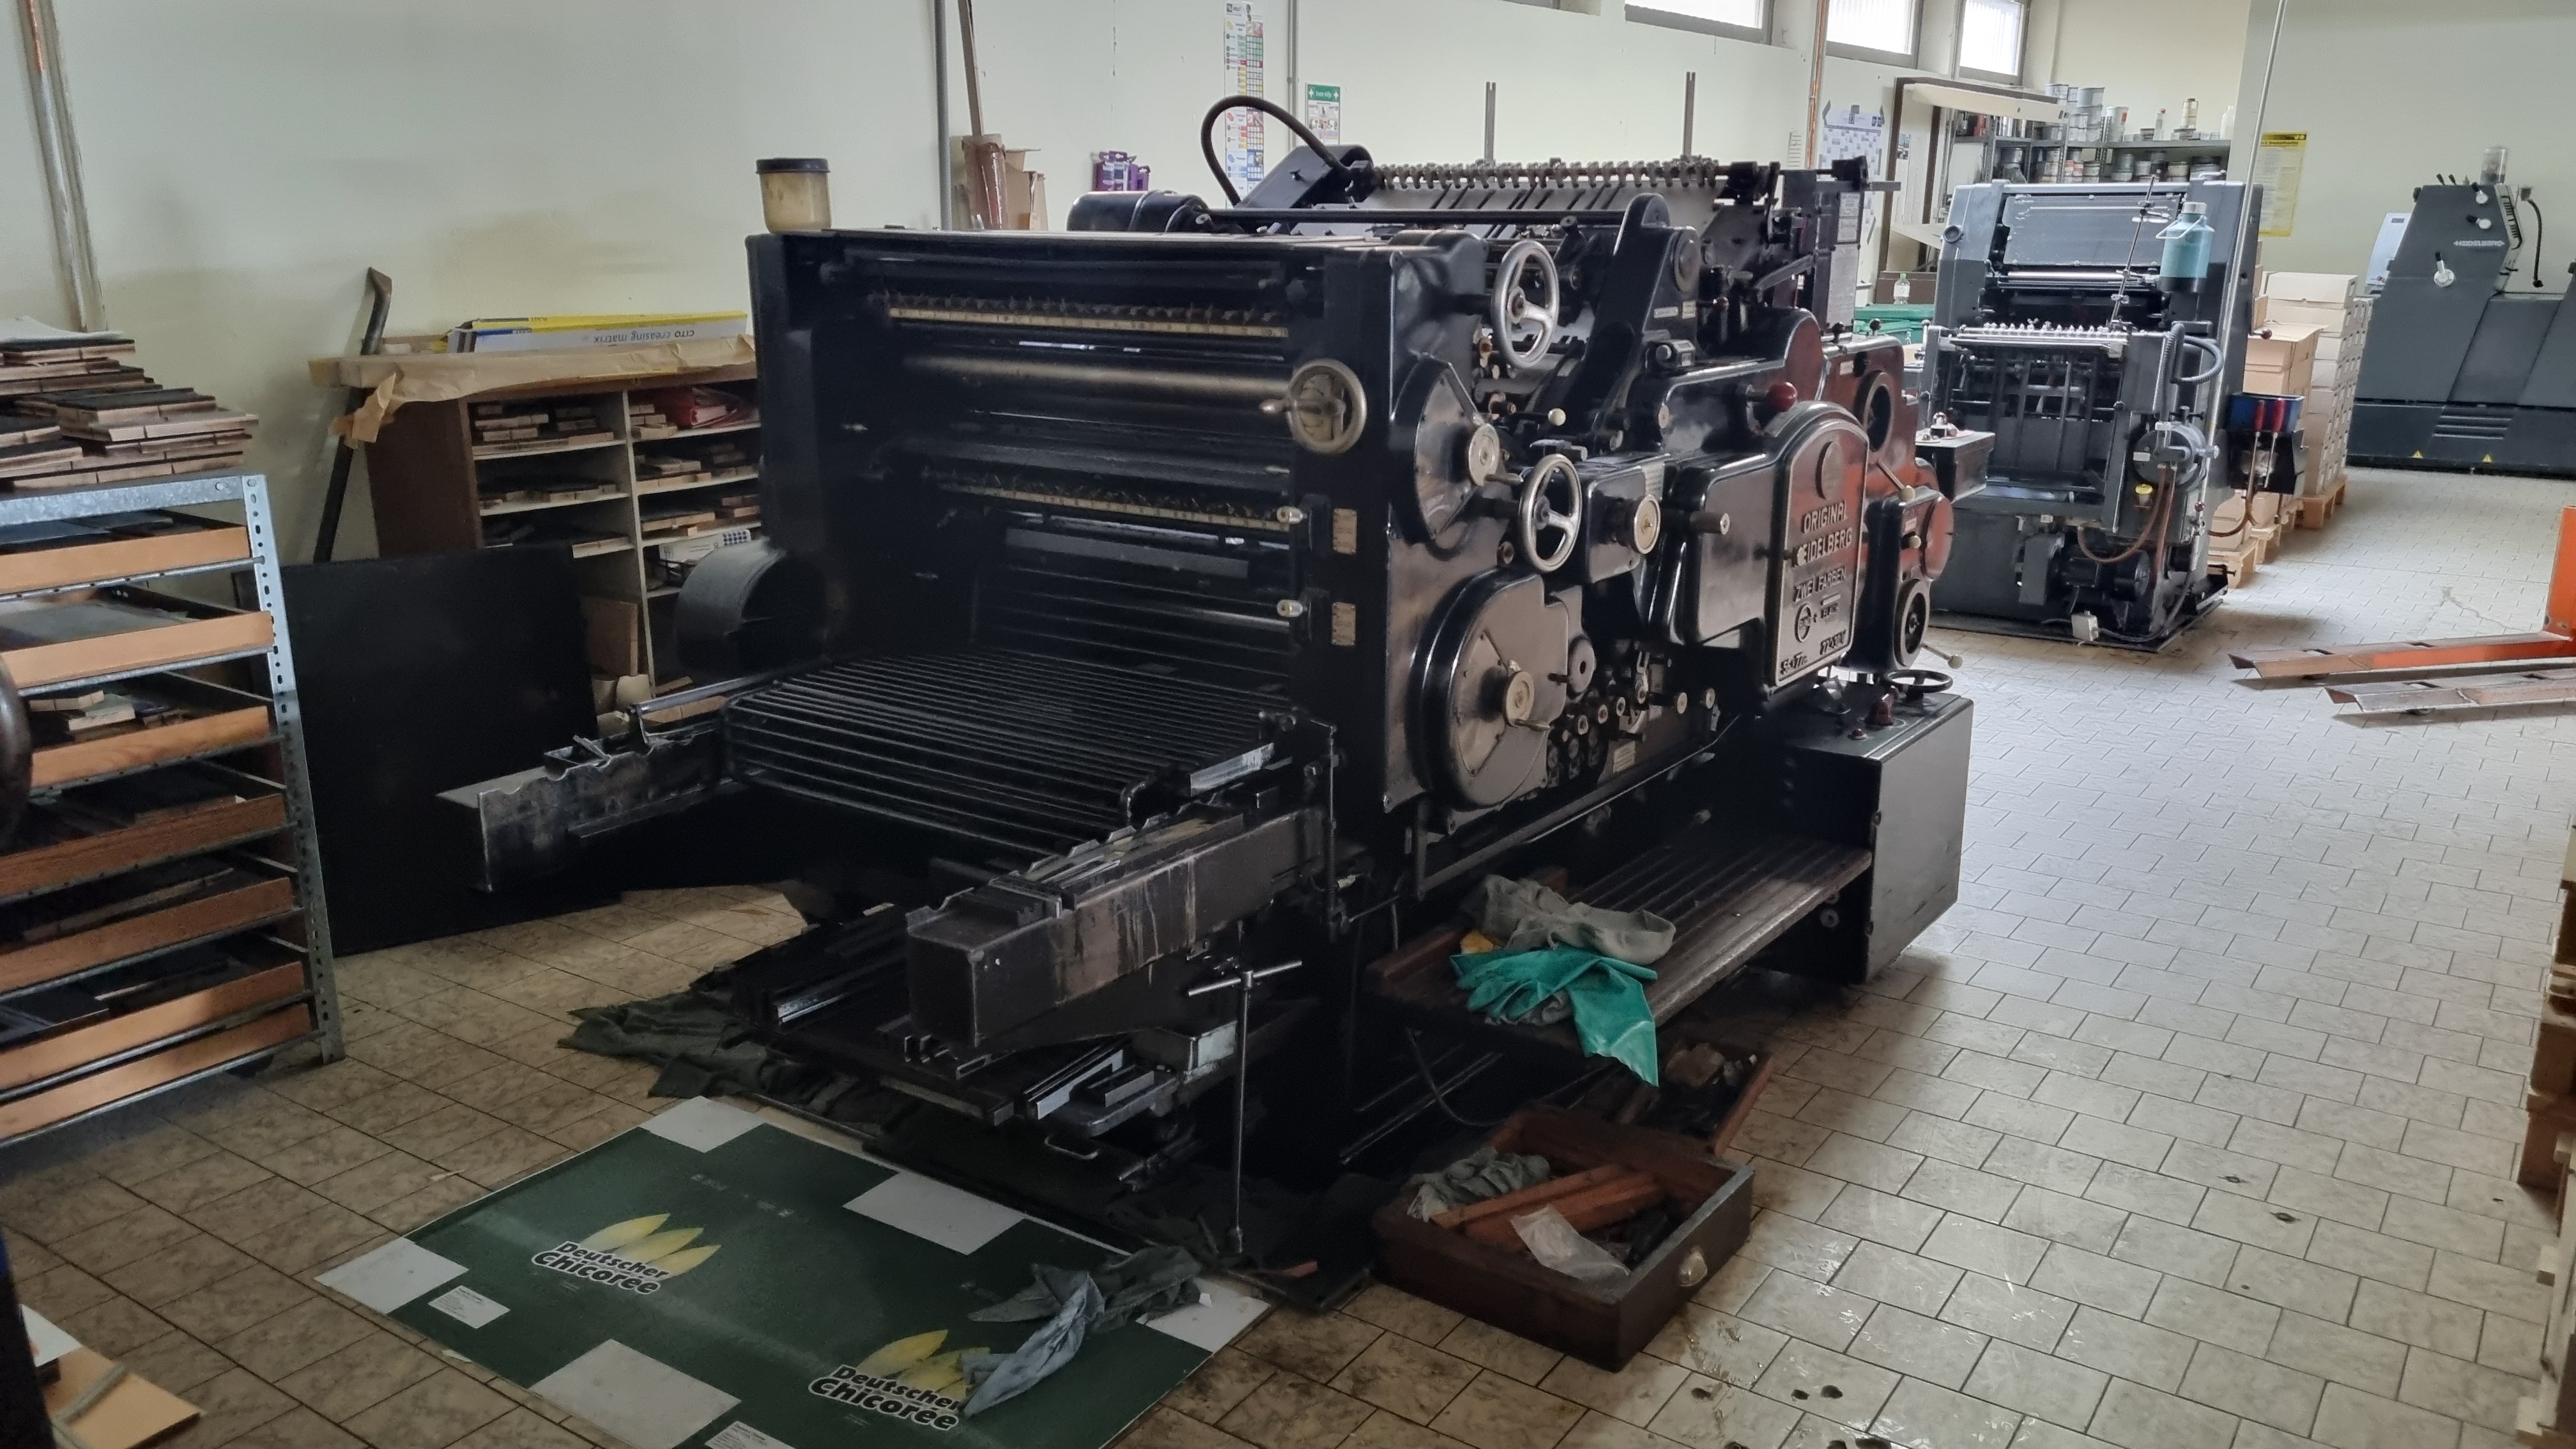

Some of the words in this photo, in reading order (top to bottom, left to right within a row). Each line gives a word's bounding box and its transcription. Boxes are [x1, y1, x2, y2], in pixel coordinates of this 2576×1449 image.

[594, 334, 627, 344] matrix
[631, 330, 671, 341] creasing
[1802, 500, 1848, 534] ORIGINAL
[1793, 527, 1852, 567] EIDELBERG
[1818, 565, 1846, 592] FARBEN
[533, 1251, 659, 1294] Chicorée
[556, 1243, 669, 1278] Deutscher
[811, 1377, 958, 1429] Chicorée
